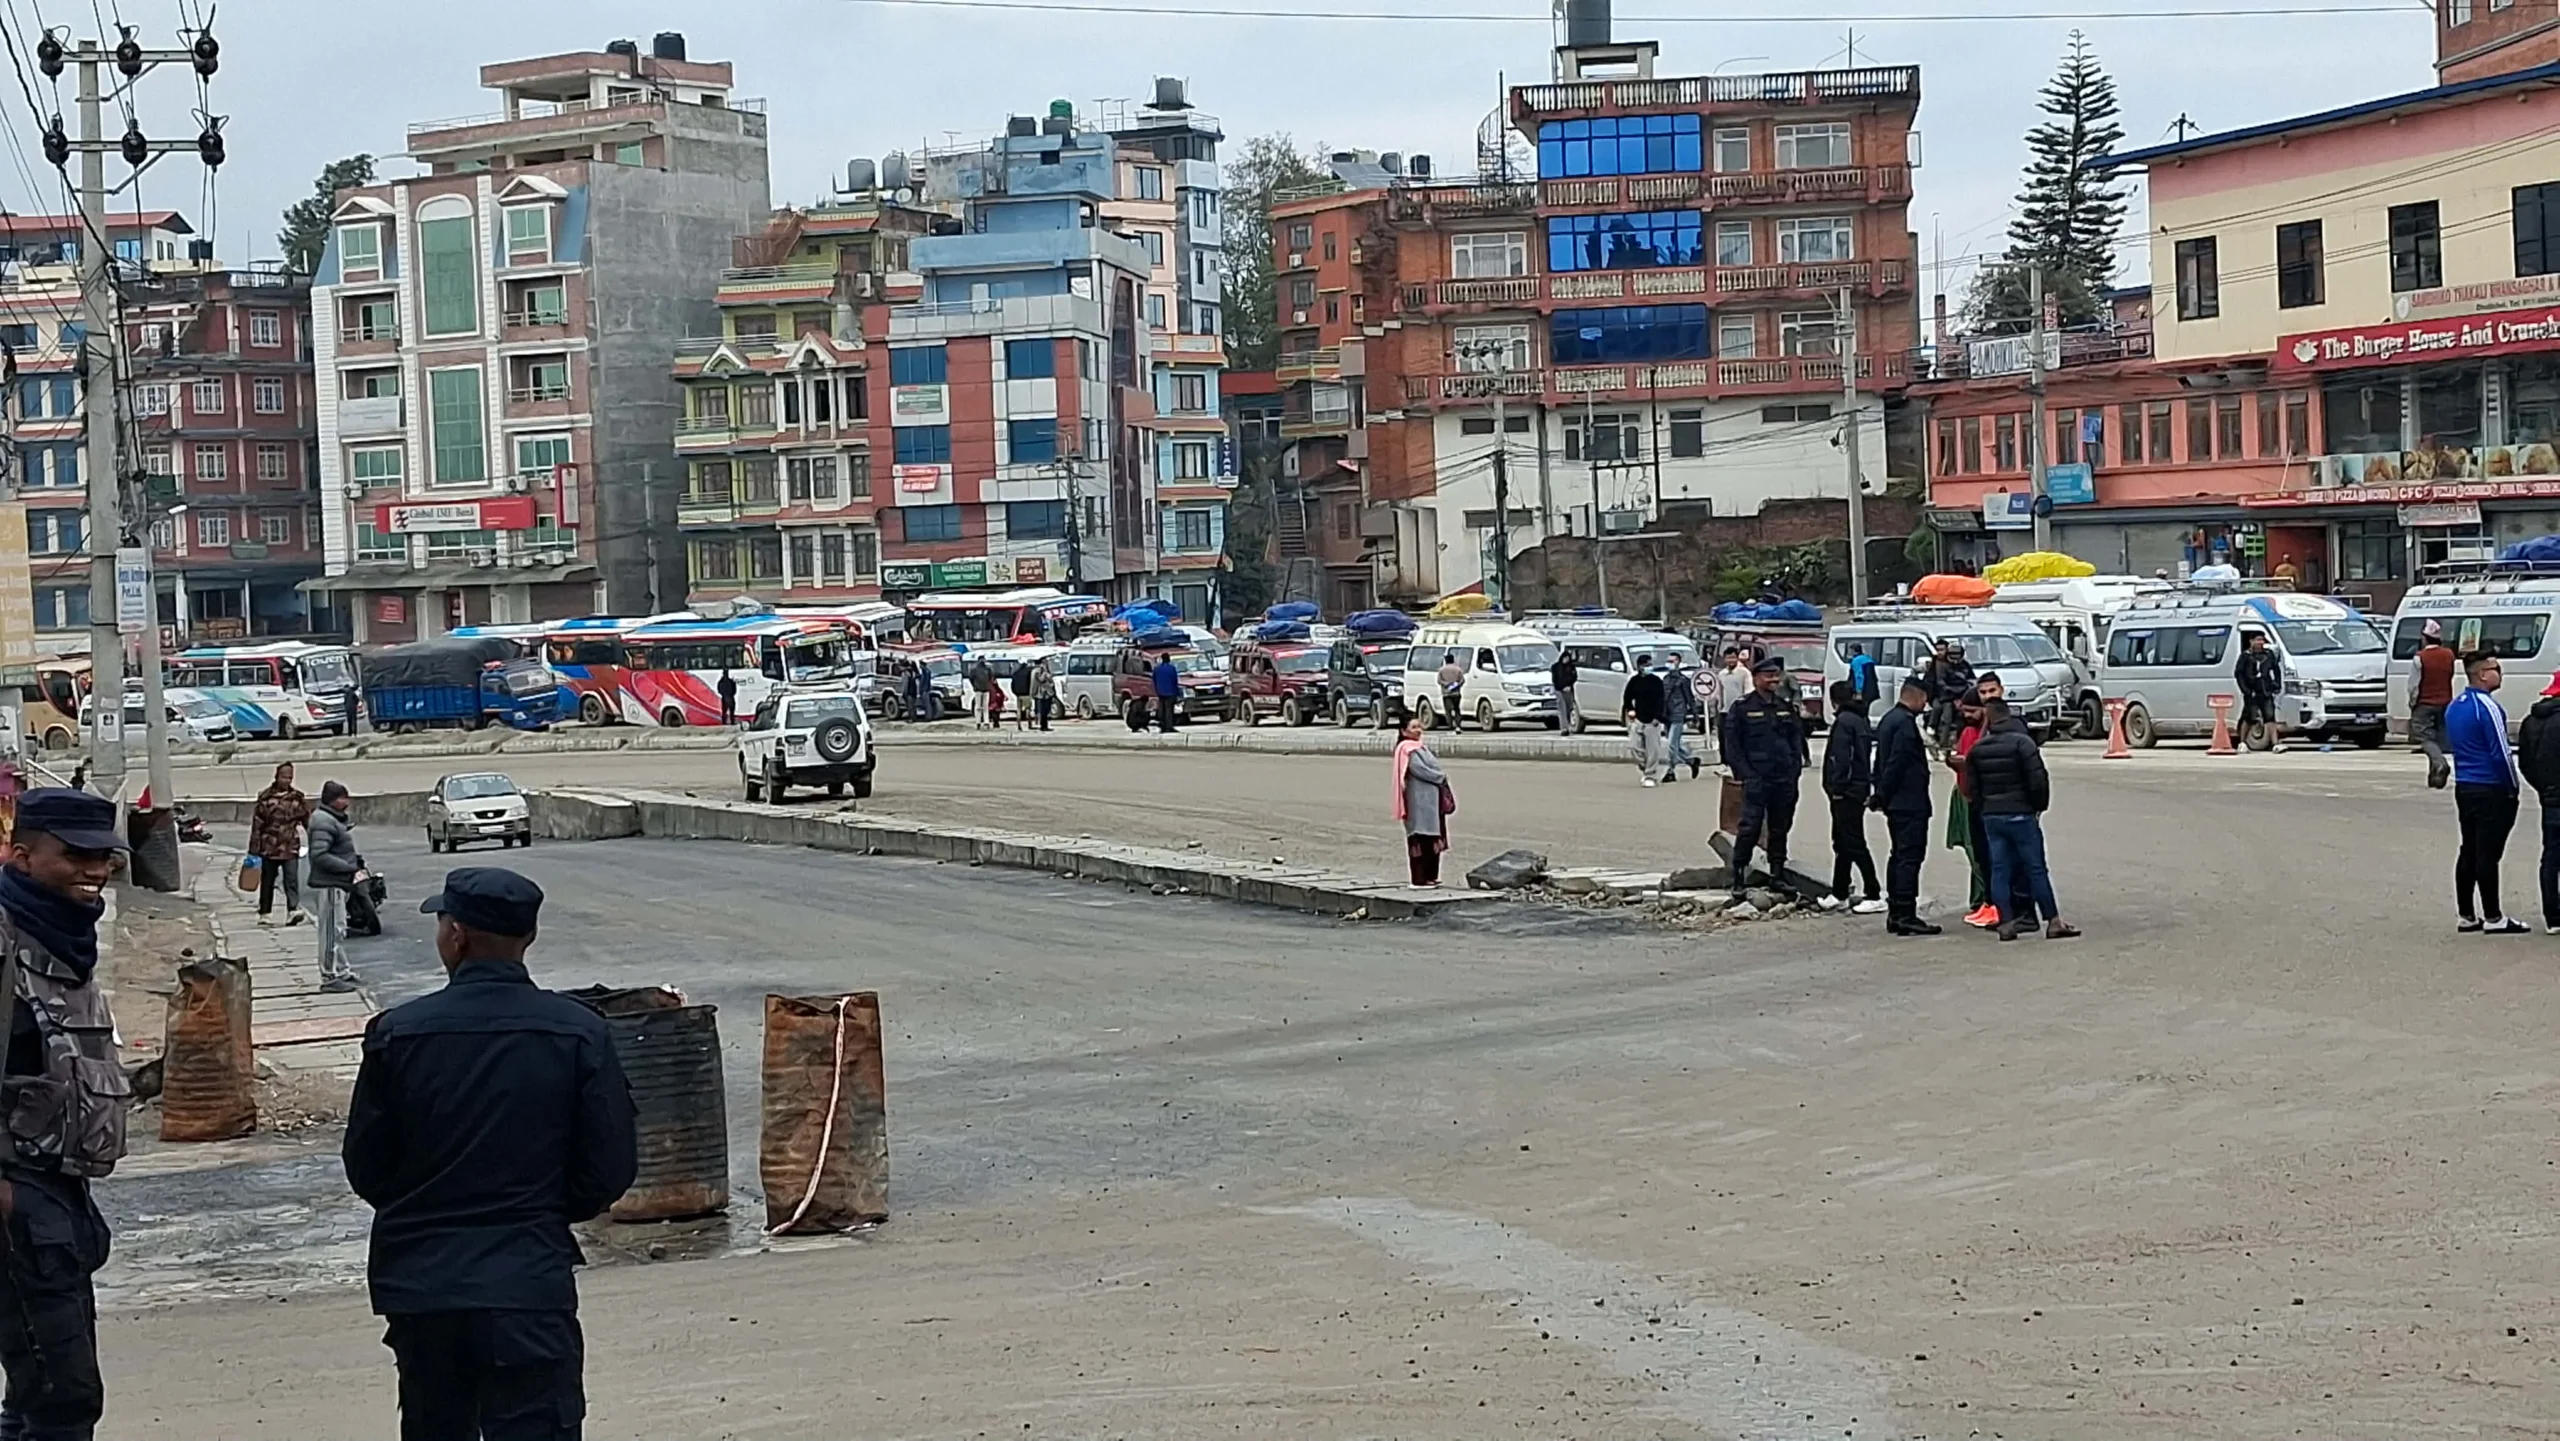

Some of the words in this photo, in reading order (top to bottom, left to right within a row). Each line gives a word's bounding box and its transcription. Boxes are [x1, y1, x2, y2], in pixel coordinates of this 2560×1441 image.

[2322, 337, 2350, 360] The
[2353, 335, 2404, 360] Burger
[2408, 328, 2456, 352] House
[2460, 320, 2493, 347] And
[883, 568, 924, 584] Carlsberg
